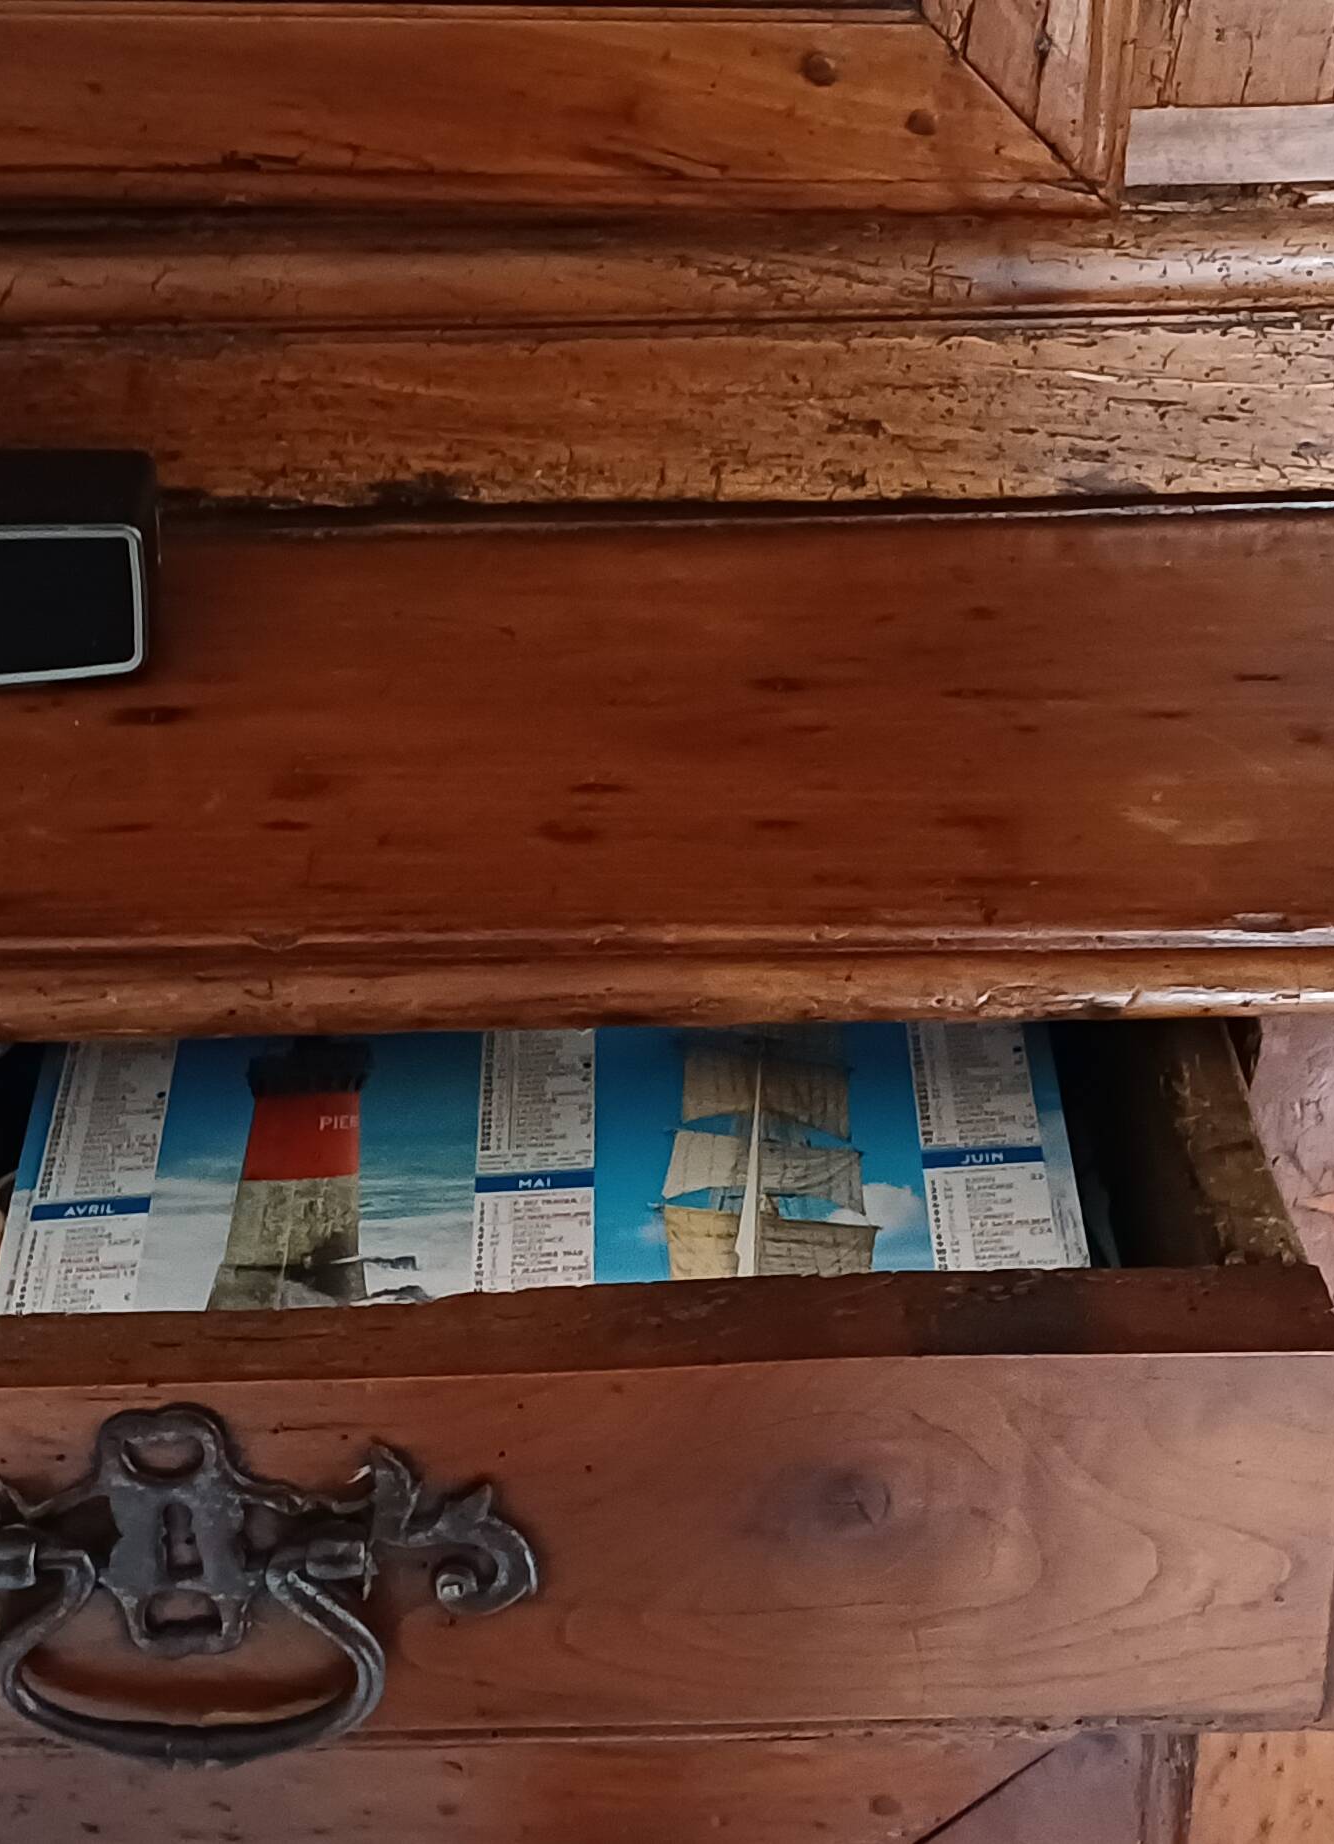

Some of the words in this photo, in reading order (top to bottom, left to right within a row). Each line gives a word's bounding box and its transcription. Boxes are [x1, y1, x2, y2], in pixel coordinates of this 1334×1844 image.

[961, 1152, 1004, 1165] JUIN
[518, 1177, 551, 1189] MAI
[63, 1203, 116, 1216] AVRIL
